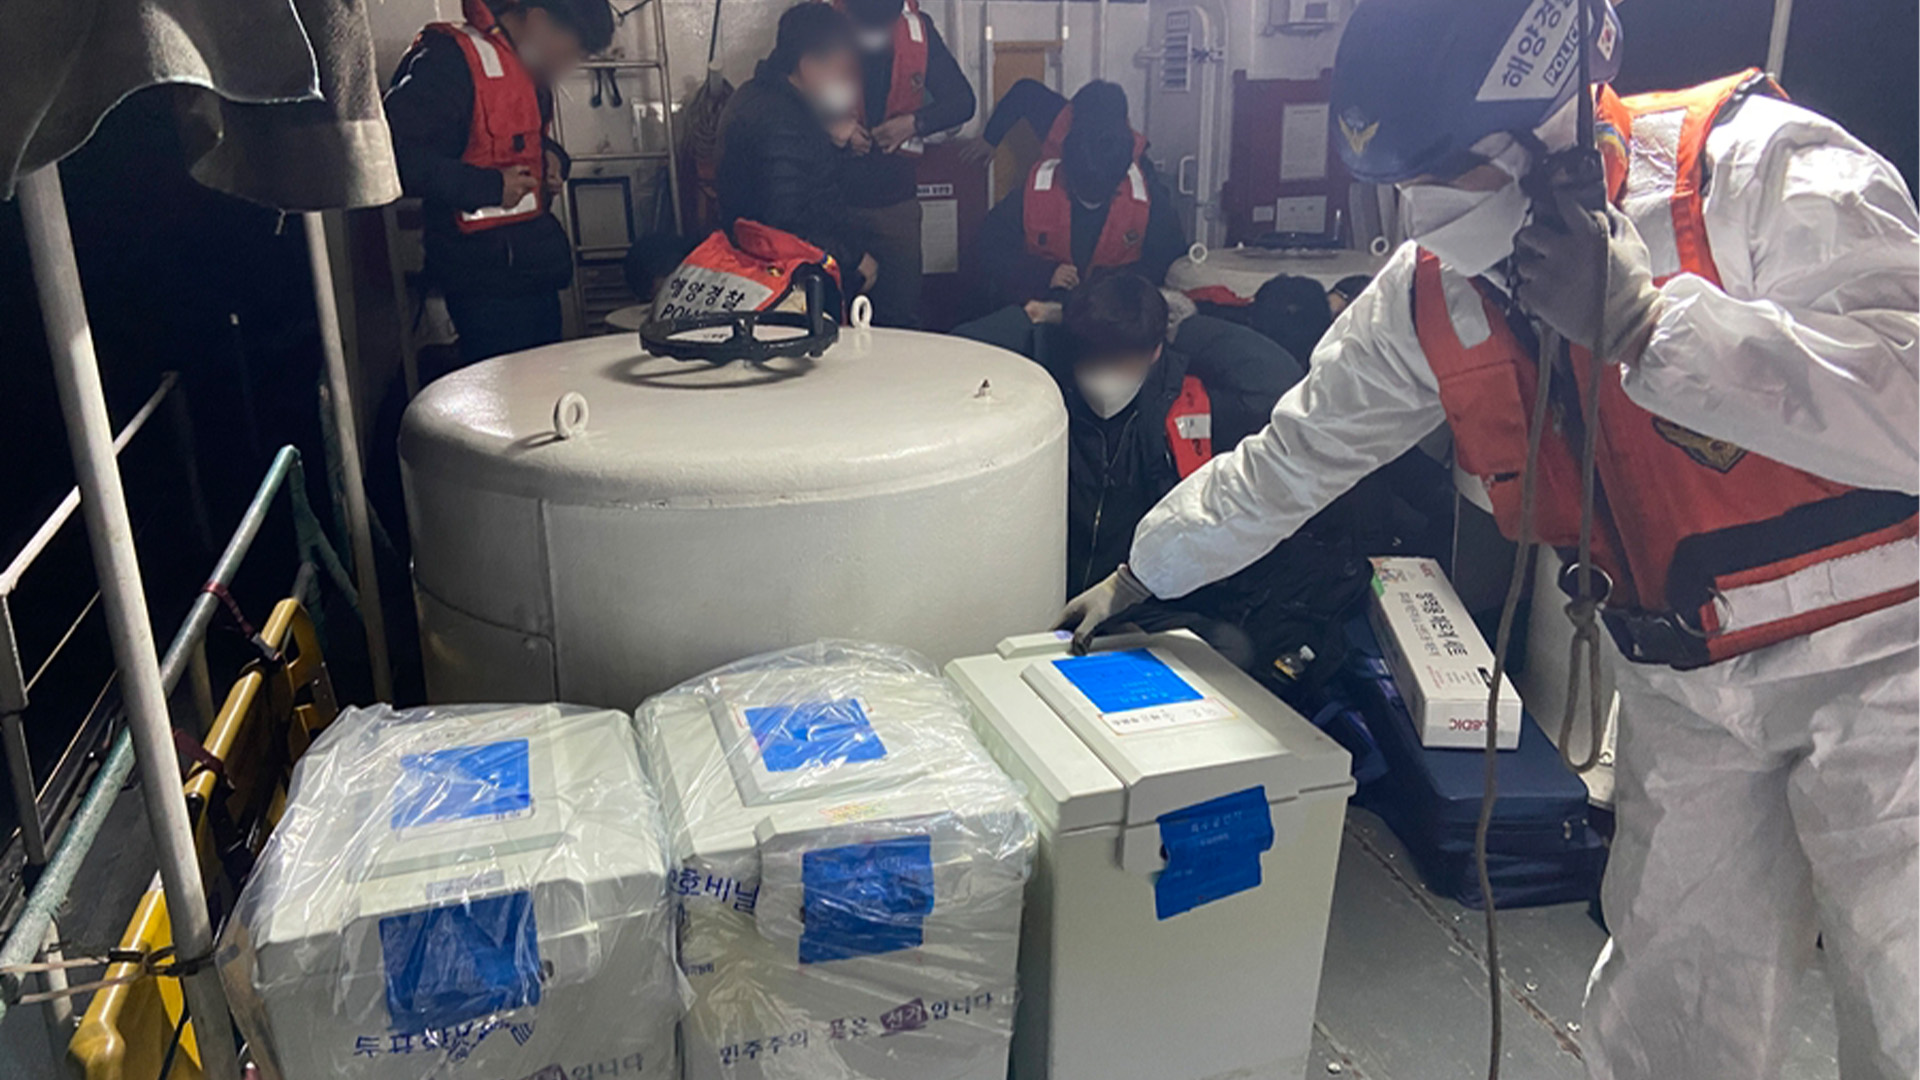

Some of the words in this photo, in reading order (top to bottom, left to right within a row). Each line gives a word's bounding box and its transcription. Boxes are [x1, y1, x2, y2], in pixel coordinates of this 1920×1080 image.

[1502, 0, 1574, 87] 해양경
[1546, 19, 1579, 82] POLIC
[669, 277, 746, 312] 해양경찰
[719, 1029, 809, 1065] 민주주의
